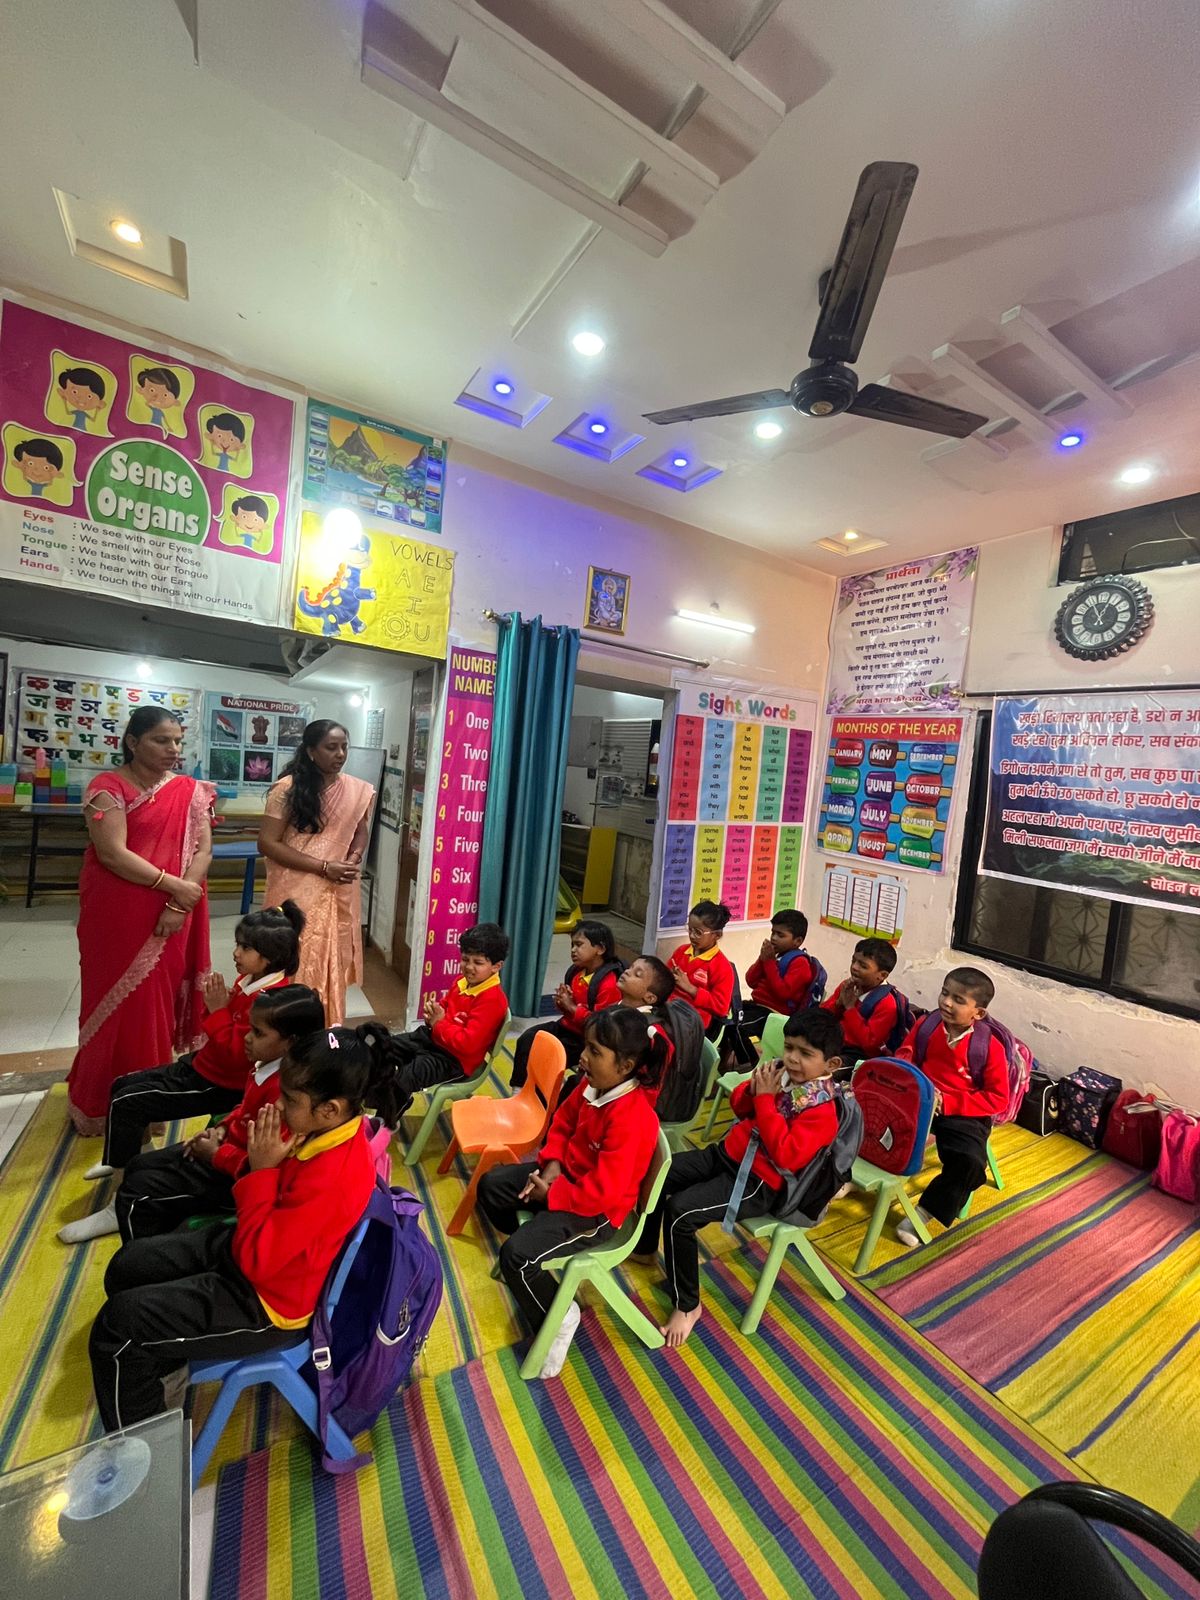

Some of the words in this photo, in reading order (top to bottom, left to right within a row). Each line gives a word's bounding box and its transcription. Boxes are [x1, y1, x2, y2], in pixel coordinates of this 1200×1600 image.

[109, 450, 193, 498] Sense
[97, 486, 200, 537] Organs
[23, 509, 54, 523] Eyes
[81, 522, 99, 533] We
[102, 529, 122, 538] see
[125, 534, 146, 544] with
[149, 540, 165, 548] our
[169, 542, 193, 554] Eyes
[22, 522, 54, 535] Nose
[80, 534, 98, 544] We
[101, 540, 129, 552] smell
[132, 547, 153, 557] with
[156, 553, 173, 561] our
[176, 555, 201, 567] Nose
[22, 533, 68, 550] Tongue
[79, 546, 97, 556] We
[101, 551, 126, 562] taste
[130, 558, 150, 568] with
[174, 566, 208, 580] Tongue
[390, 540, 454, 571] VOWELS
[20, 546, 49, 558] Ears
[78, 558, 96, 568] We
[100, 562, 124, 574] hear
[127, 568, 148, 578] with
[150, 573, 167, 582] our
[170, 577, 193, 588] Ears
[20, 558, 60, 572] Hands
[77, 569, 96, 579] We
[100, 574, 128, 586] touch
[132, 580, 148, 590] the
[150, 584, 181, 597] things
[184, 591, 203, 601] with
[206, 596, 221, 604] our
[224, 598, 253, 611] Hands
[395, 568, 411, 588] A
[423, 574, 436, 593] E
[406, 596, 422, 615] I
[414, 622, 430, 642] U
[454, 675, 494, 696] NAME
[228, 699, 268, 710] NATIONAL
[270, 702, 294, 712] PRIDE
[698, 692, 742, 716] Sight
[748, 700, 796, 721] Words
[448, 710, 454, 726] 1
[466, 712, 489, 730] One
[836, 722, 878, 734] MONTHS
[881, 722, 896, 734] OF
[899, 724, 921, 734] THE
[924, 724, 956, 736] YEAR
[444, 742, 452, 758] 2
[464, 743, 488, 761] Two
[836, 750, 862, 758] JANUARY
[872, 750, 892, 760] MAY
[441, 774, 448, 790] 3
[868, 779, 892, 792] JUNE
[906, 784, 940, 795] OCTOBER
[438, 805, 446, 820] 4
[458, 806, 484, 822] Four
[863, 808, 887, 822] JULY
[436, 836, 444, 852] 5
[454, 837, 480, 853] Five
[858, 840, 886, 852] AUGUST
[900, 848, 930, 860] DECEMBER
[433, 868, 440, 884] 6
[452, 868, 472, 884] Six
[431, 900, 438, 914] 7
[449, 898, 478, 914] Seve
[428, 930, 434, 946] 8
[425, 961, 432, 976] 9
